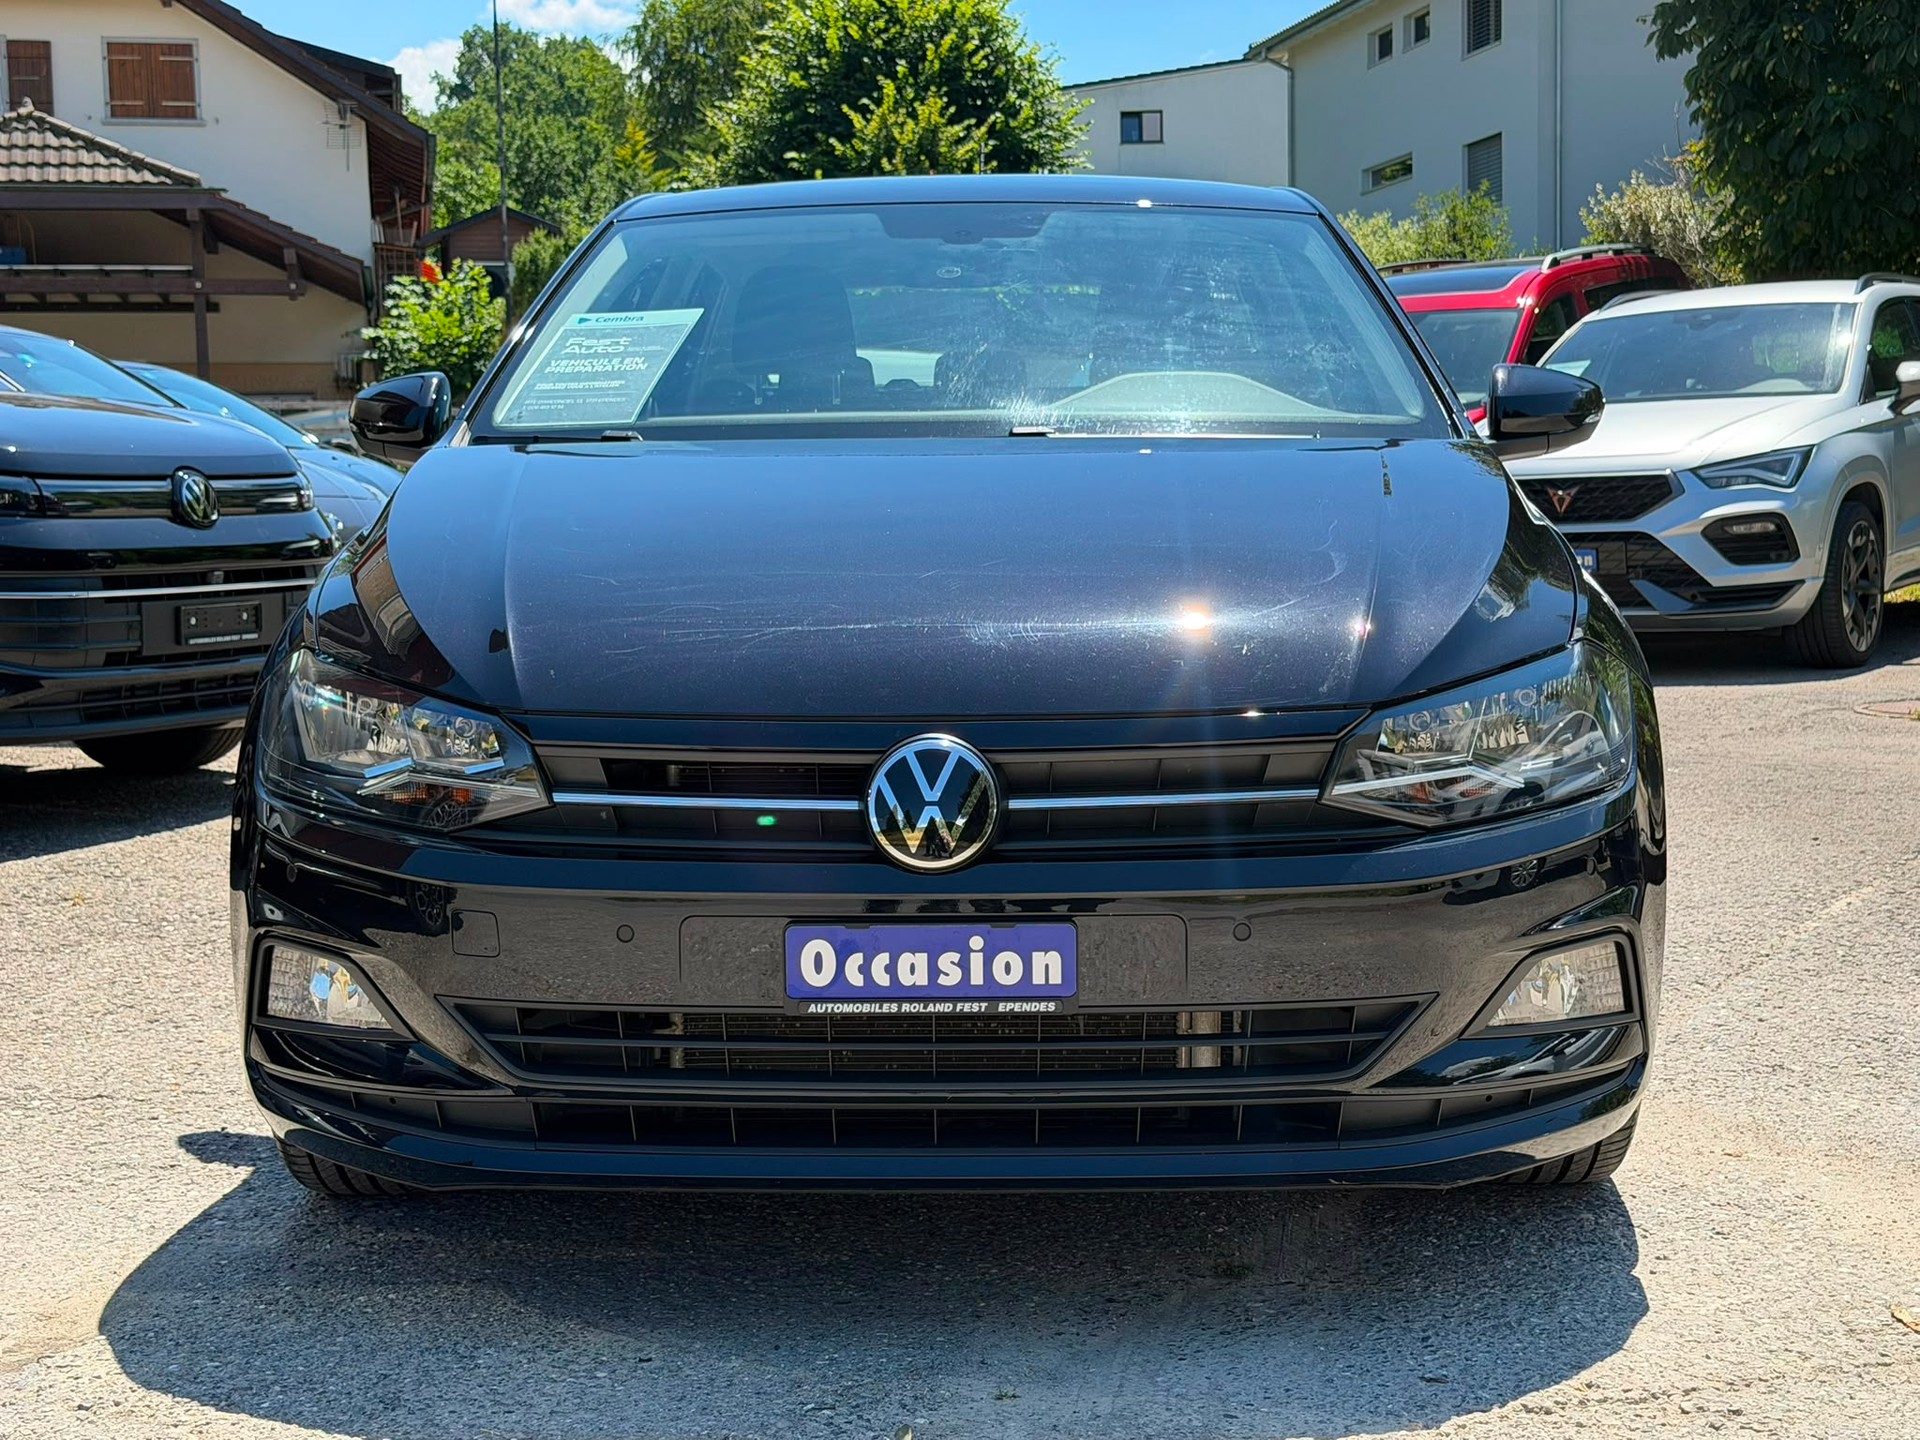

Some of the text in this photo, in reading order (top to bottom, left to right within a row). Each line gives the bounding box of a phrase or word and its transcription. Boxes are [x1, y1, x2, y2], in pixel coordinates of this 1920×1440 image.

[595, 315, 644, 323] Cembra
[567, 337, 631, 345] Fest
[562, 345, 624, 354] Auto
[623, 357, 646, 365] EN
[800, 935, 1063, 987] Occasion
[808, 1002, 1056, 1013] AUTOMOBILES ROLAND FEST EPENDES
